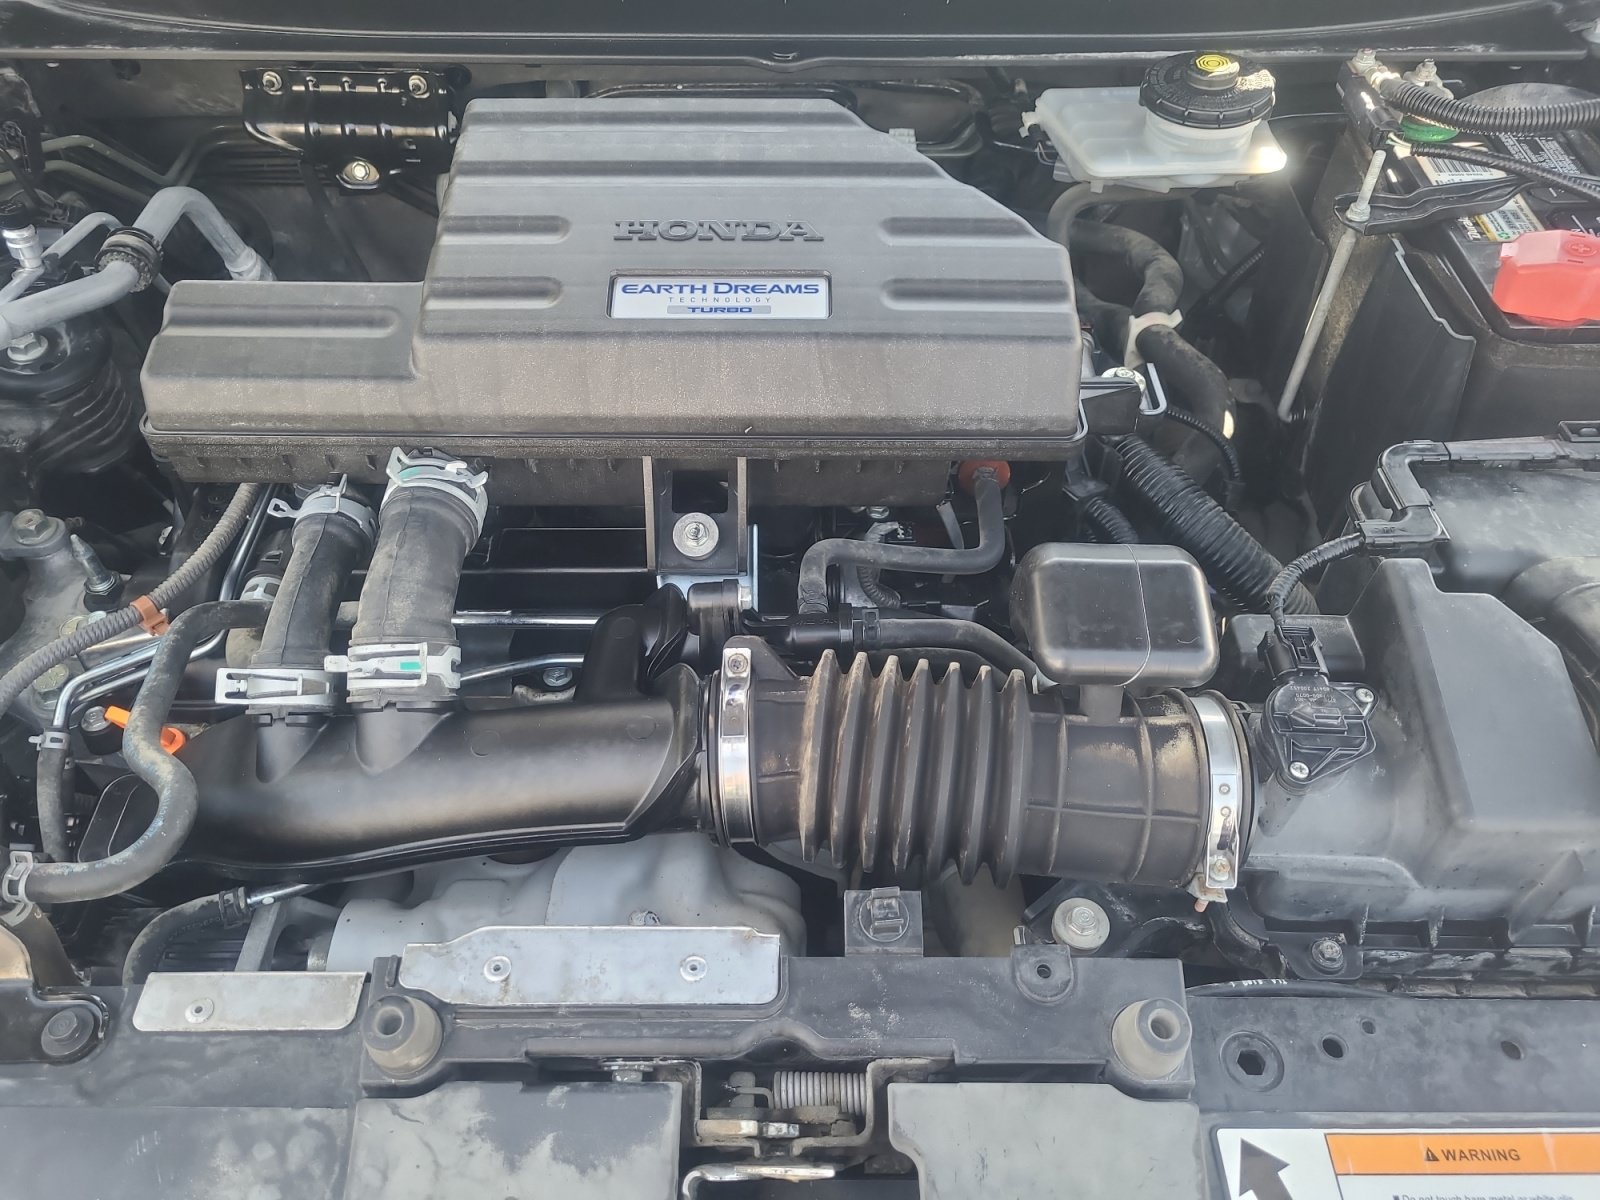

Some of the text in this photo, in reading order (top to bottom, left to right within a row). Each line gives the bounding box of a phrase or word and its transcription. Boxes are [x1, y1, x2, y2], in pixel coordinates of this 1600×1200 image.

[613, 220, 824, 241] HONDA
[621, 282, 819, 294] EARTH DREAMS
[1441, 1149, 1520, 1161] WARNING
